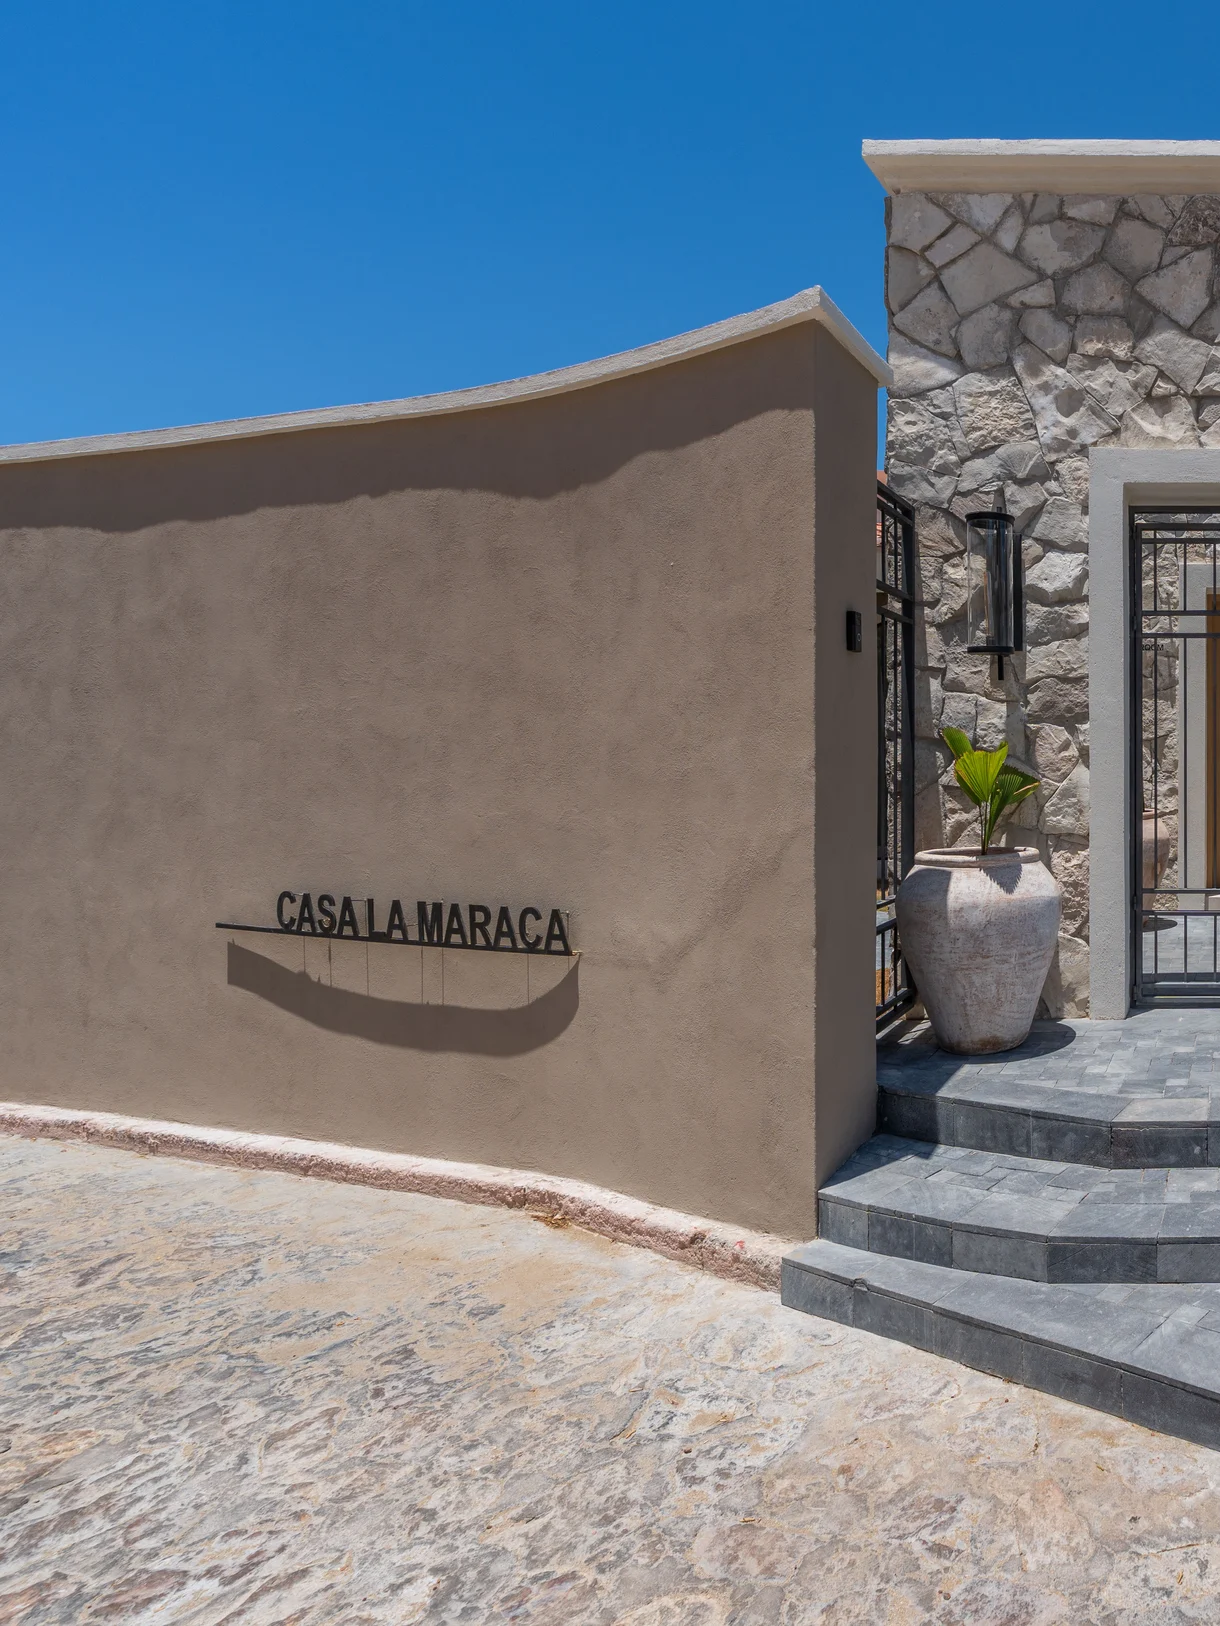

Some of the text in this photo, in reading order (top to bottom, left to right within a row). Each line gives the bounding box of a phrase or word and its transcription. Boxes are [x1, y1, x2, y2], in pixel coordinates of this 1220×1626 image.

[277, 890, 571, 954] CASA LA MARACA
